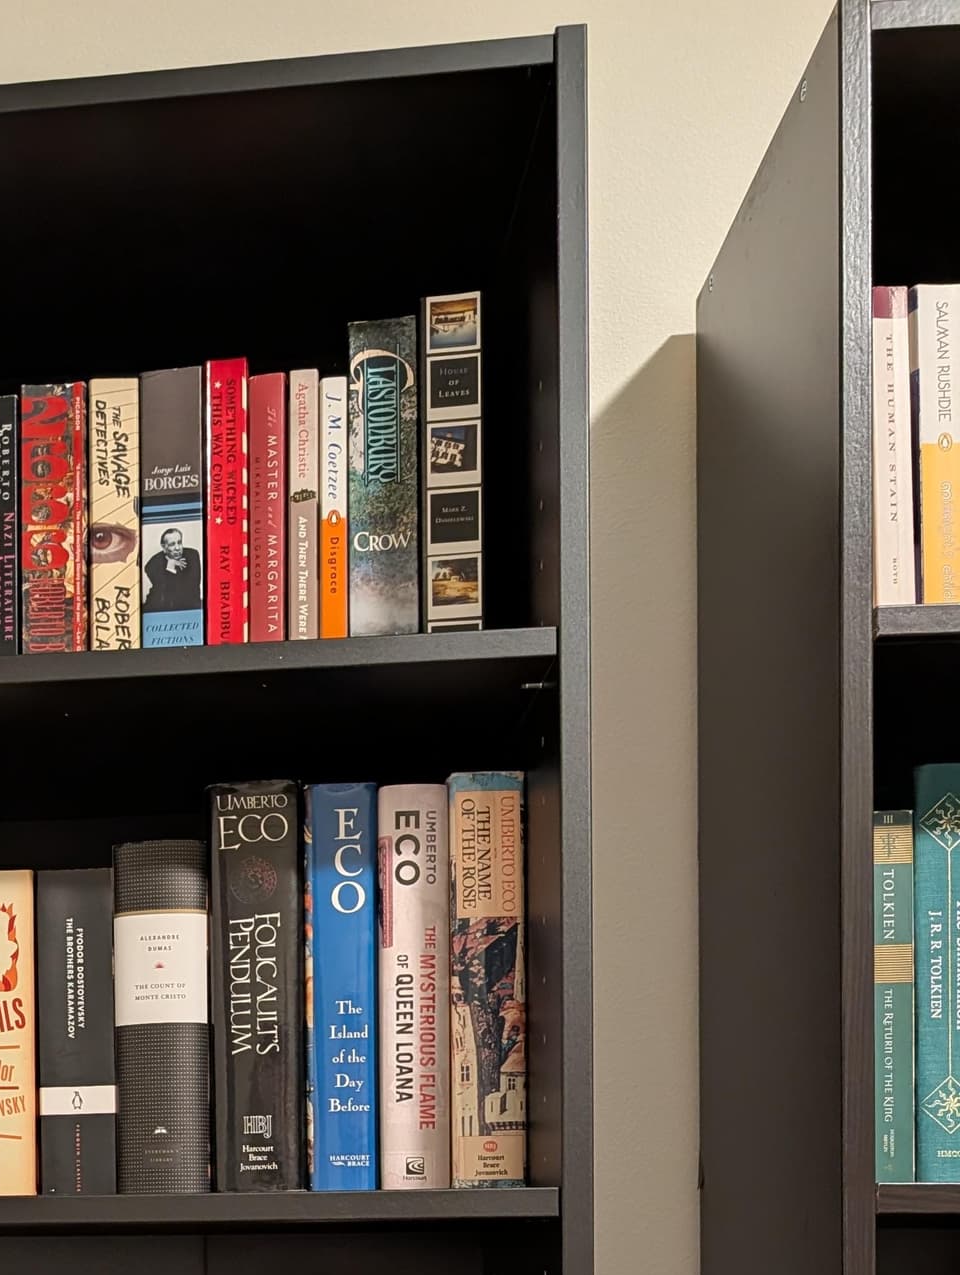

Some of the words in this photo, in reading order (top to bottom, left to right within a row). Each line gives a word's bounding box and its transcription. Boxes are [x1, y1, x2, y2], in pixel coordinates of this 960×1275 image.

[935, 301, 950, 361] SALMAN
[886, 334, 895, 371] THE
[297, 382, 310, 426] Agatha
[938, 368, 952, 422] RUSHDIE
[887, 384, 895, 451] HUMAN
[95, 400, 110, 487] DETECTIVES
[297, 428, 310, 479] Christie
[143, 475, 200, 491] BORGES
[151, 465, 172, 476] Jorge
[173, 464, 191, 474] Luis
[889, 464, 897, 523] STAIN
[216, 793, 288, 811] UMBERTO
[460, 798, 476, 817] OF
[218, 812, 289, 851] ECO
[460, 825, 476, 858] THE
[476, 806, 492, 843] THE
[330, 808, 366, 914] ECO
[393, 810, 421, 887] ECO
[425, 810, 437, 885] UMBERTO
[460, 868, 477, 909] ROSE
[476, 849, 492, 901] NAME
[65, 917, 73, 932] THE
[883, 870, 895, 941] TOLKIEN
[66, 935, 74, 978] BROTHERS
[76, 928, 84, 963] FYODOR
[424, 926, 435, 951] THE
[397, 954, 408, 971] OF
[76, 966, 85, 1029] DOSTOYEVSKY
[161, 993, 187, 1001] CRISTO
[229, 917, 255, 1056] PENDULUM
[254, 911, 281, 1056] FOUCAULT'S
[395, 973, 413, 1034] QUEEN
[67, 981, 75, 1039] KARAMAZOV
[335, 1000, 363, 1015] The
[419, 954, 437, 1067] MYSTERIOUS
[329, 1024, 368, 1040] Island
[331, 1049, 345, 1065] of
[347, 1050, 366, 1065] the
[395, 1037, 413, 1104] LOANA
[335, 1074, 364, 1092] Day
[419, 1071, 437, 1131] FLAME
[328, 1099, 370, 1114] Before
[239, 1162, 278, 1172] Jovanovich
[242, 1145, 274, 1153] Harcourt
[248, 1153, 268, 1162] Brace
